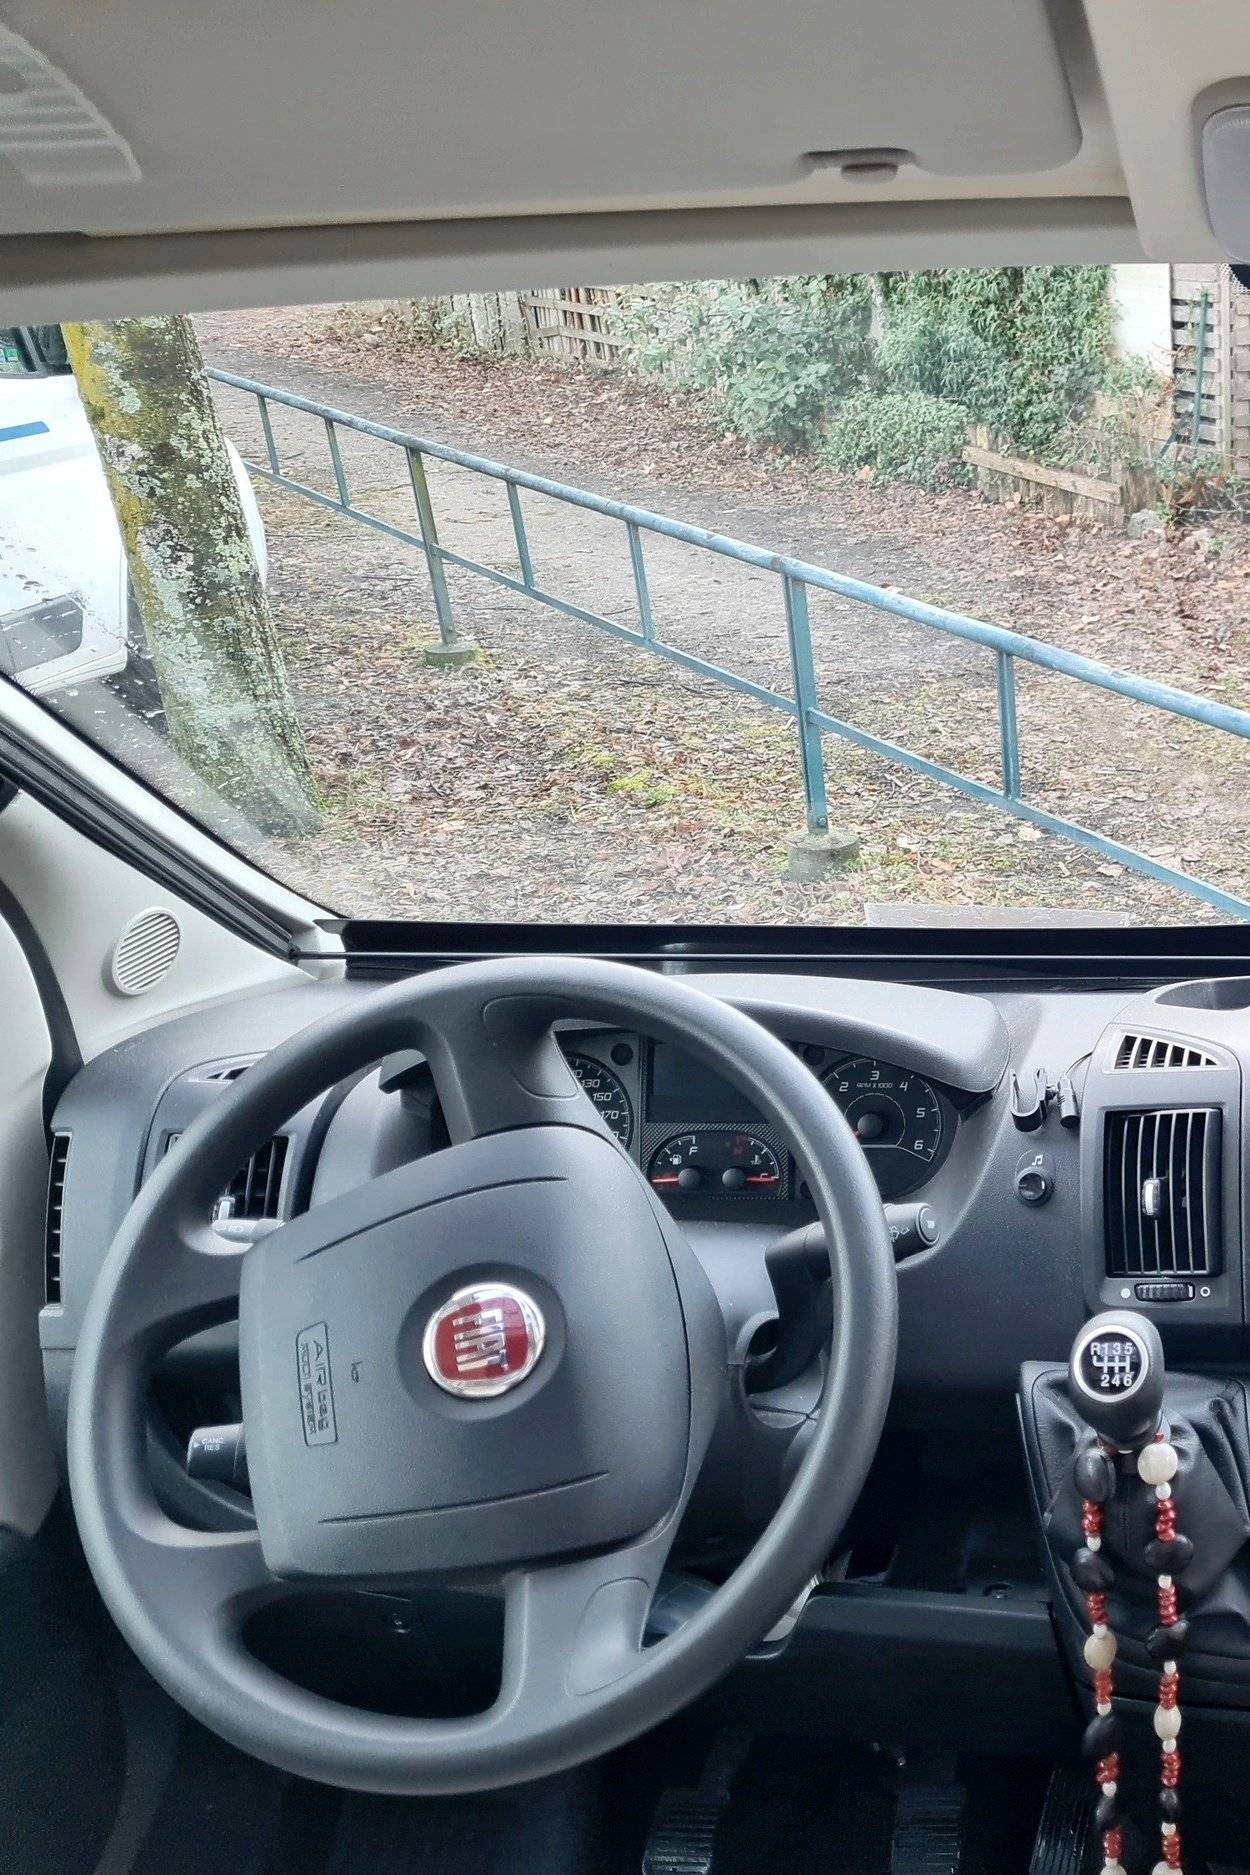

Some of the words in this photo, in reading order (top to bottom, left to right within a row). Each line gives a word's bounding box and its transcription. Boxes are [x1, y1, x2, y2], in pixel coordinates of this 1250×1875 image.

[870, 1070, 880, 1081] 3
[580, 1079, 601, 1088] 130
[839, 1081, 849, 1092] 2
[899, 1081, 909, 1092] 4
[592, 1092, 612, 1101] 150
[600, 1110, 620, 1119] 170
[916, 1107, 926, 1118] 5
[914, 1139, 924, 1151] 6
[688, 1146, 698, 1156] F
[452, 1308, 509, 1372] FIAT
